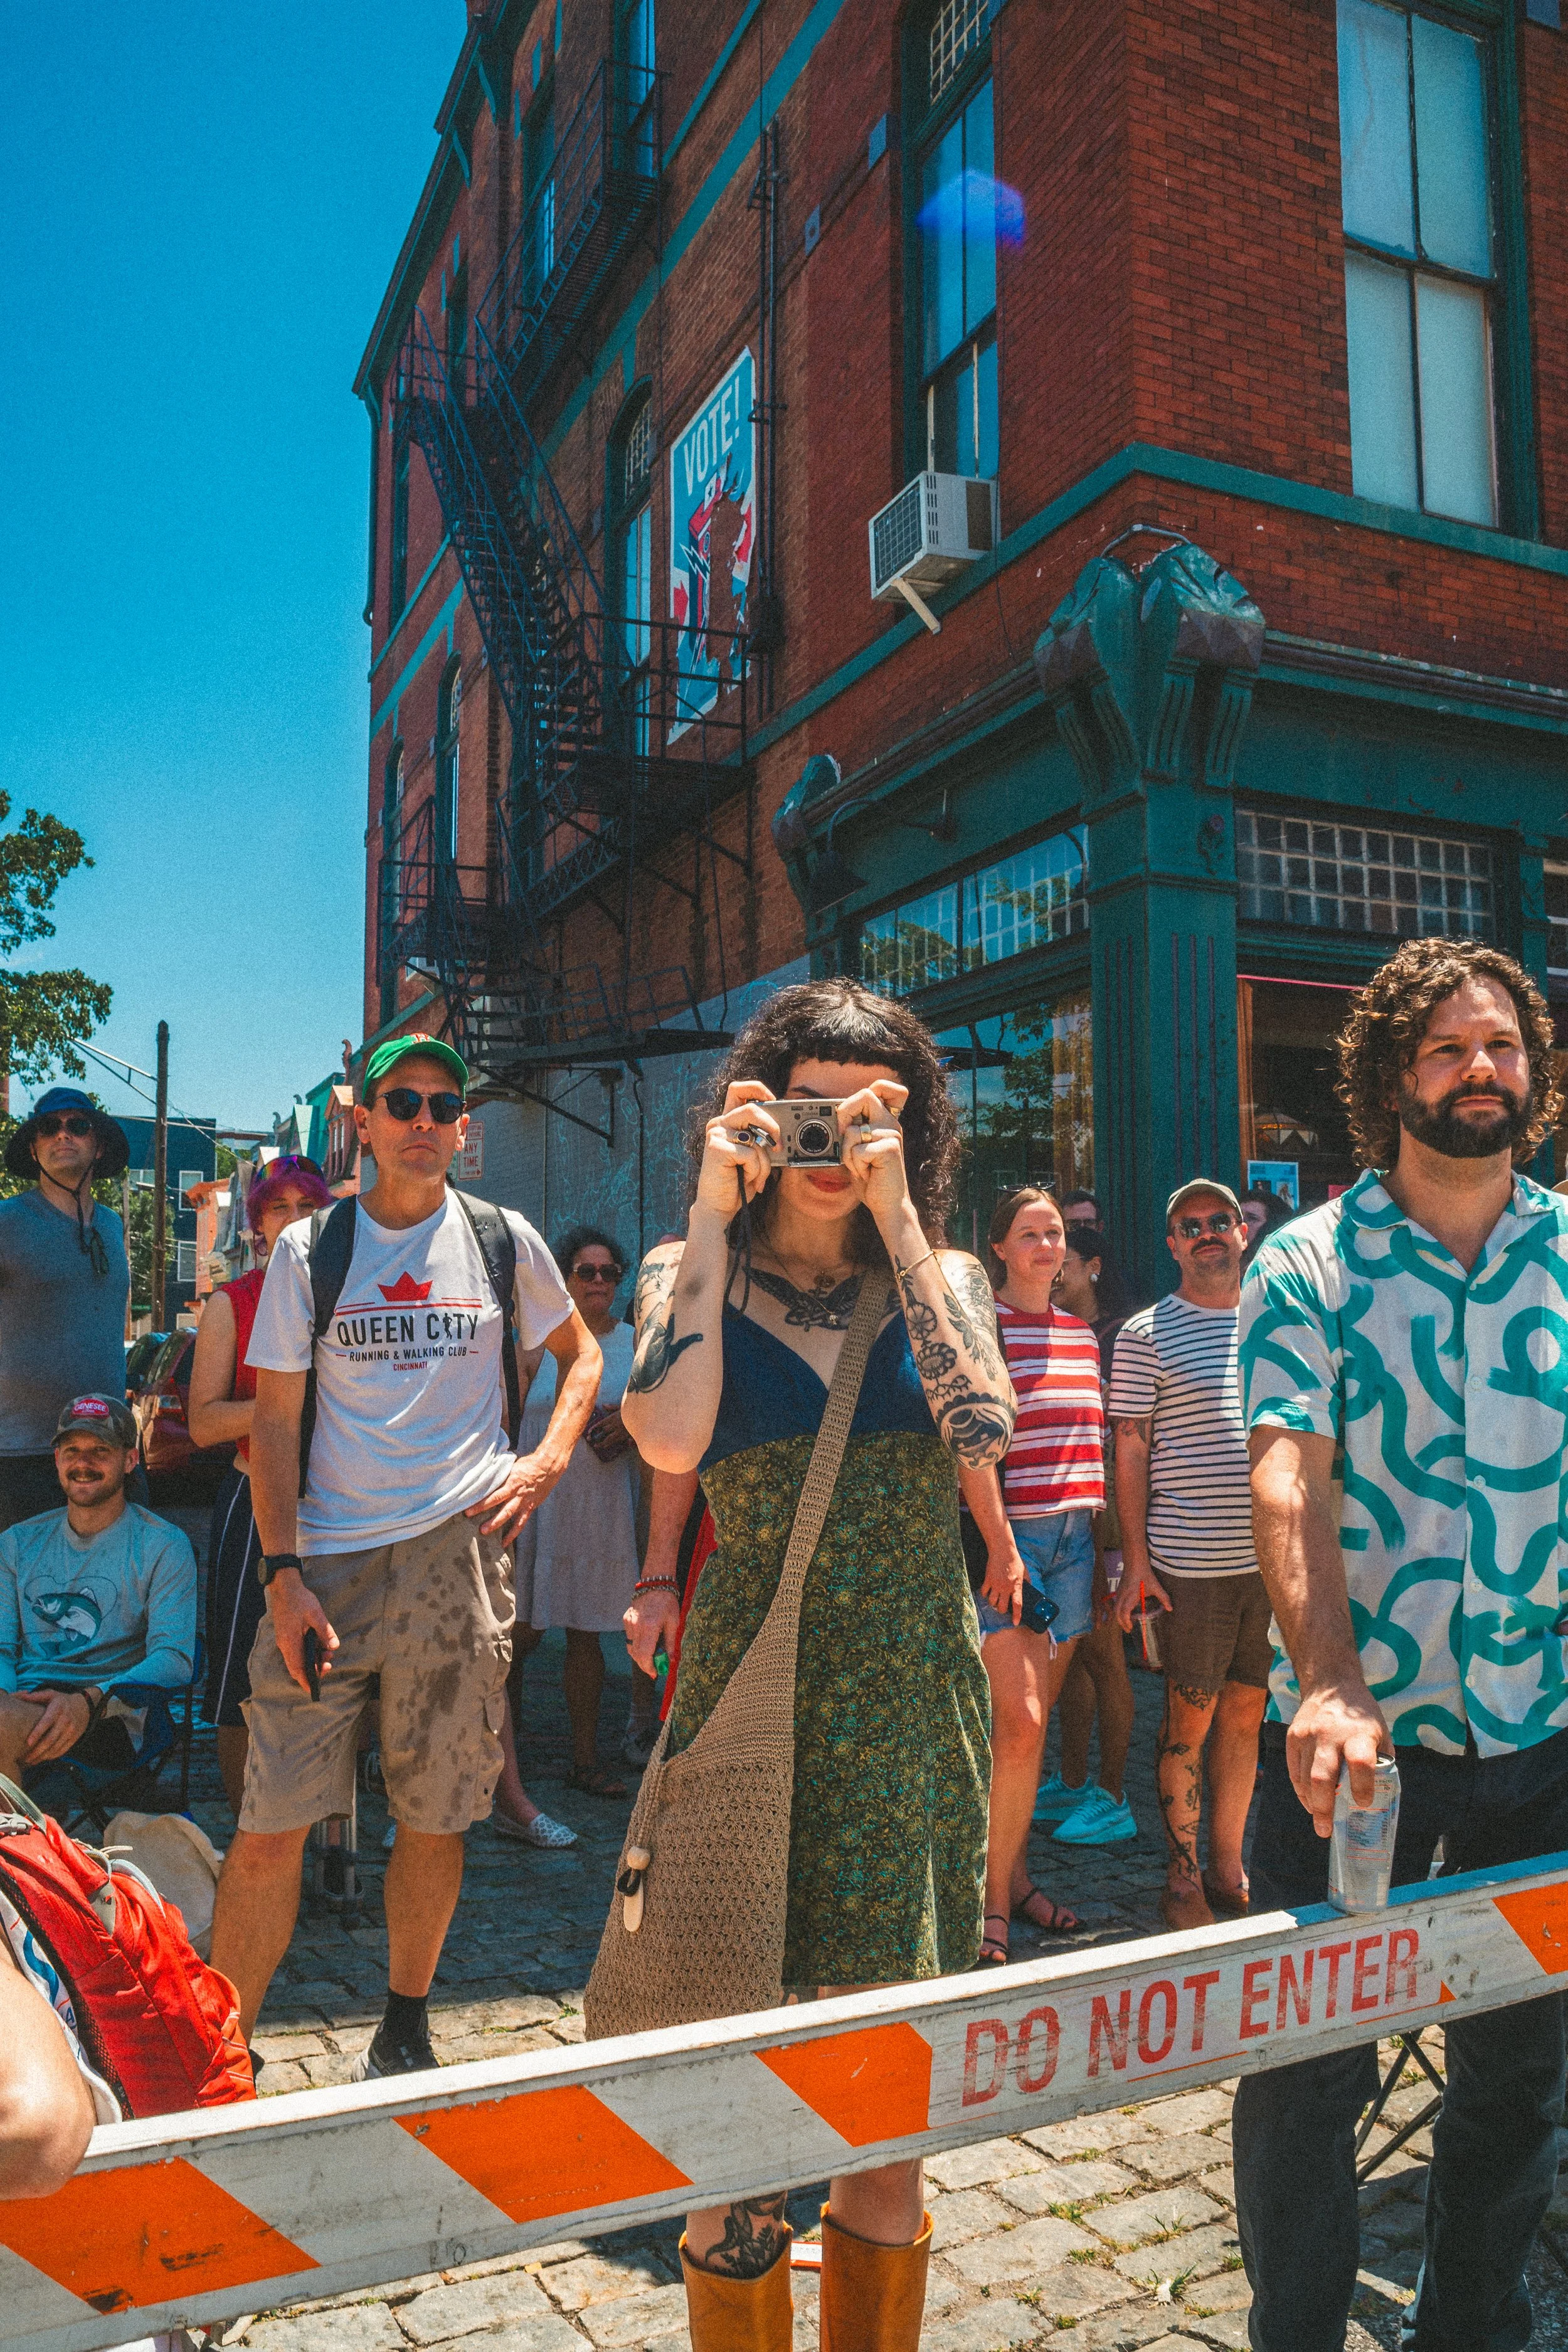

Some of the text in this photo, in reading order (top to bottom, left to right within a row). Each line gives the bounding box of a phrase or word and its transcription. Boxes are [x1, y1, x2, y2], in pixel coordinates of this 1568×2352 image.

[684, 375, 739, 496] VOTE!
[464, 1143, 478, 1154] ANY
[464, 1156, 478, 1167] TIME
[337, 1313, 478, 1347] QUEEN CITY
[349, 1345, 467, 1362] RUNNING & WALKING CLUB
[393, 1361, 427, 1370] CINCINNATI
[74, 1402, 106, 1412] GENESEE
[961, 1928, 1419, 2106] DO NOT ENTER
